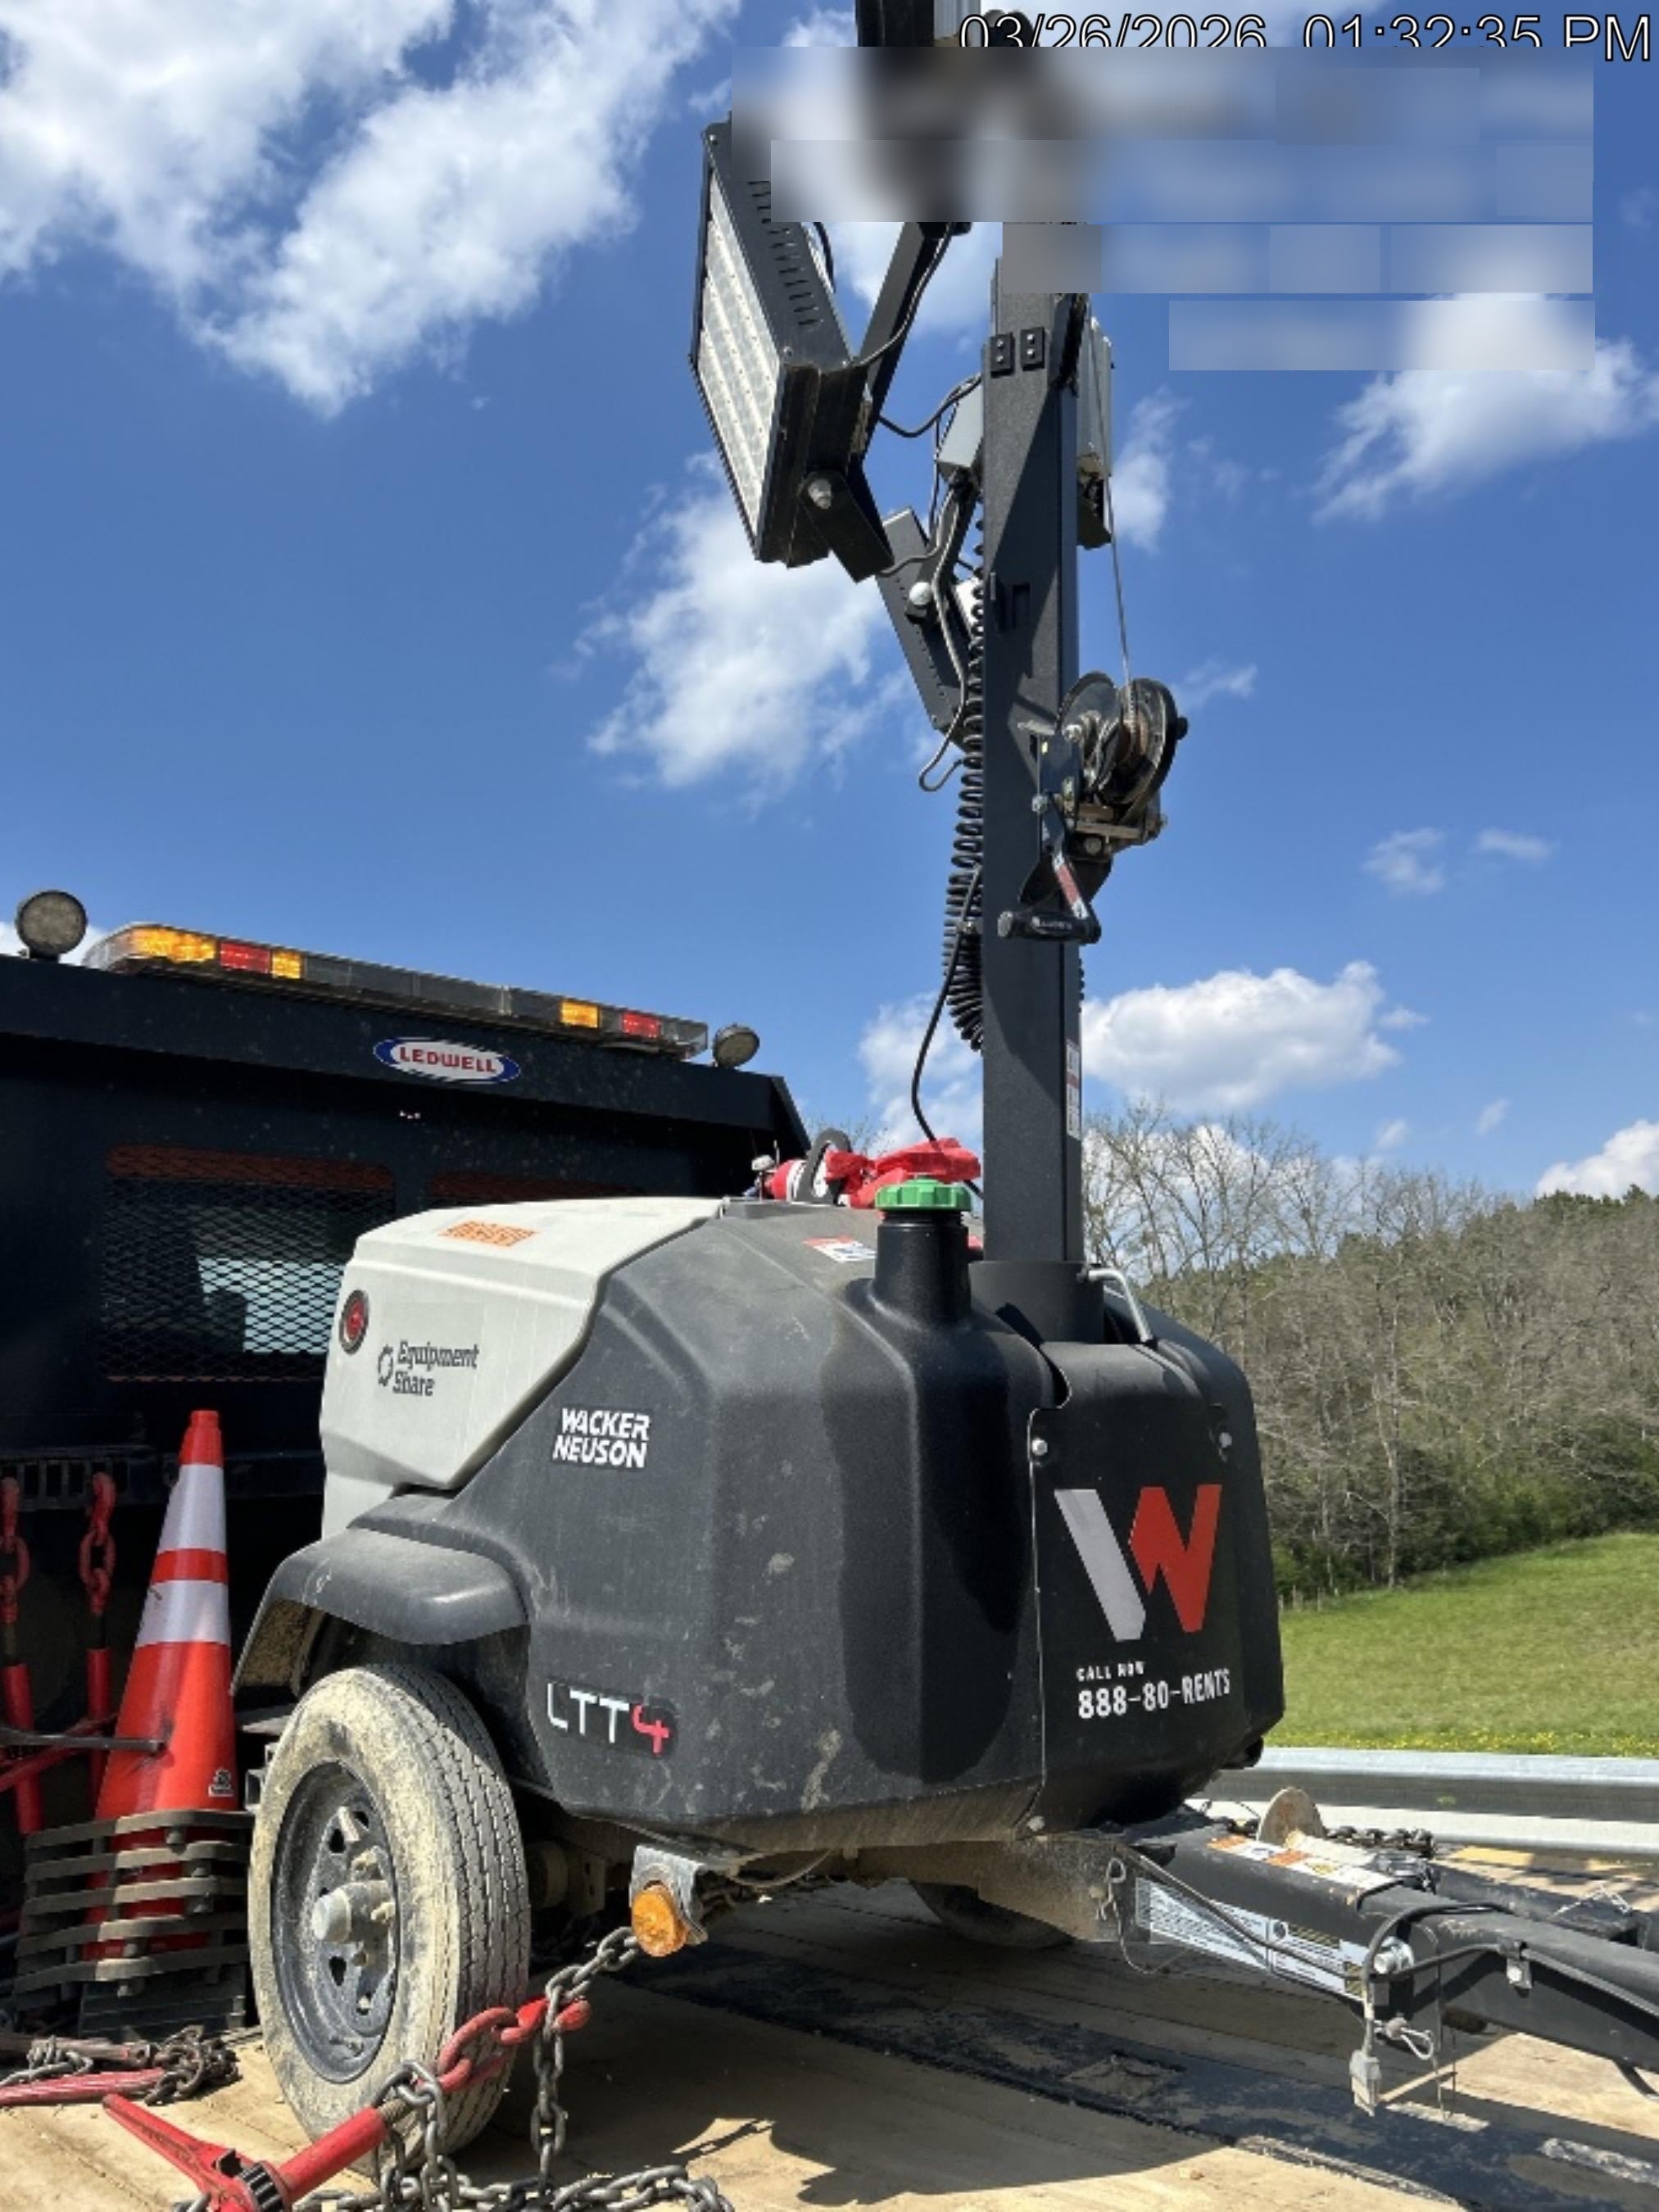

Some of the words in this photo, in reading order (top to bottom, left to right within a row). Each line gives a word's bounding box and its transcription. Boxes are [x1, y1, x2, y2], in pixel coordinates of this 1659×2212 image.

[399, 1046, 496, 1072] LEDWELL
[397, 1340, 479, 1371] Equipment
[392, 1371, 435, 1397] Share
[562, 1407, 650, 1441] WACKER
[552, 1435, 647, 1468] NEUSON
[1076, 1665, 1112, 1682] CALL
[1077, 1668, 1231, 1720] 888-80-RENTS
[546, 1683, 670, 1755] LTT4
